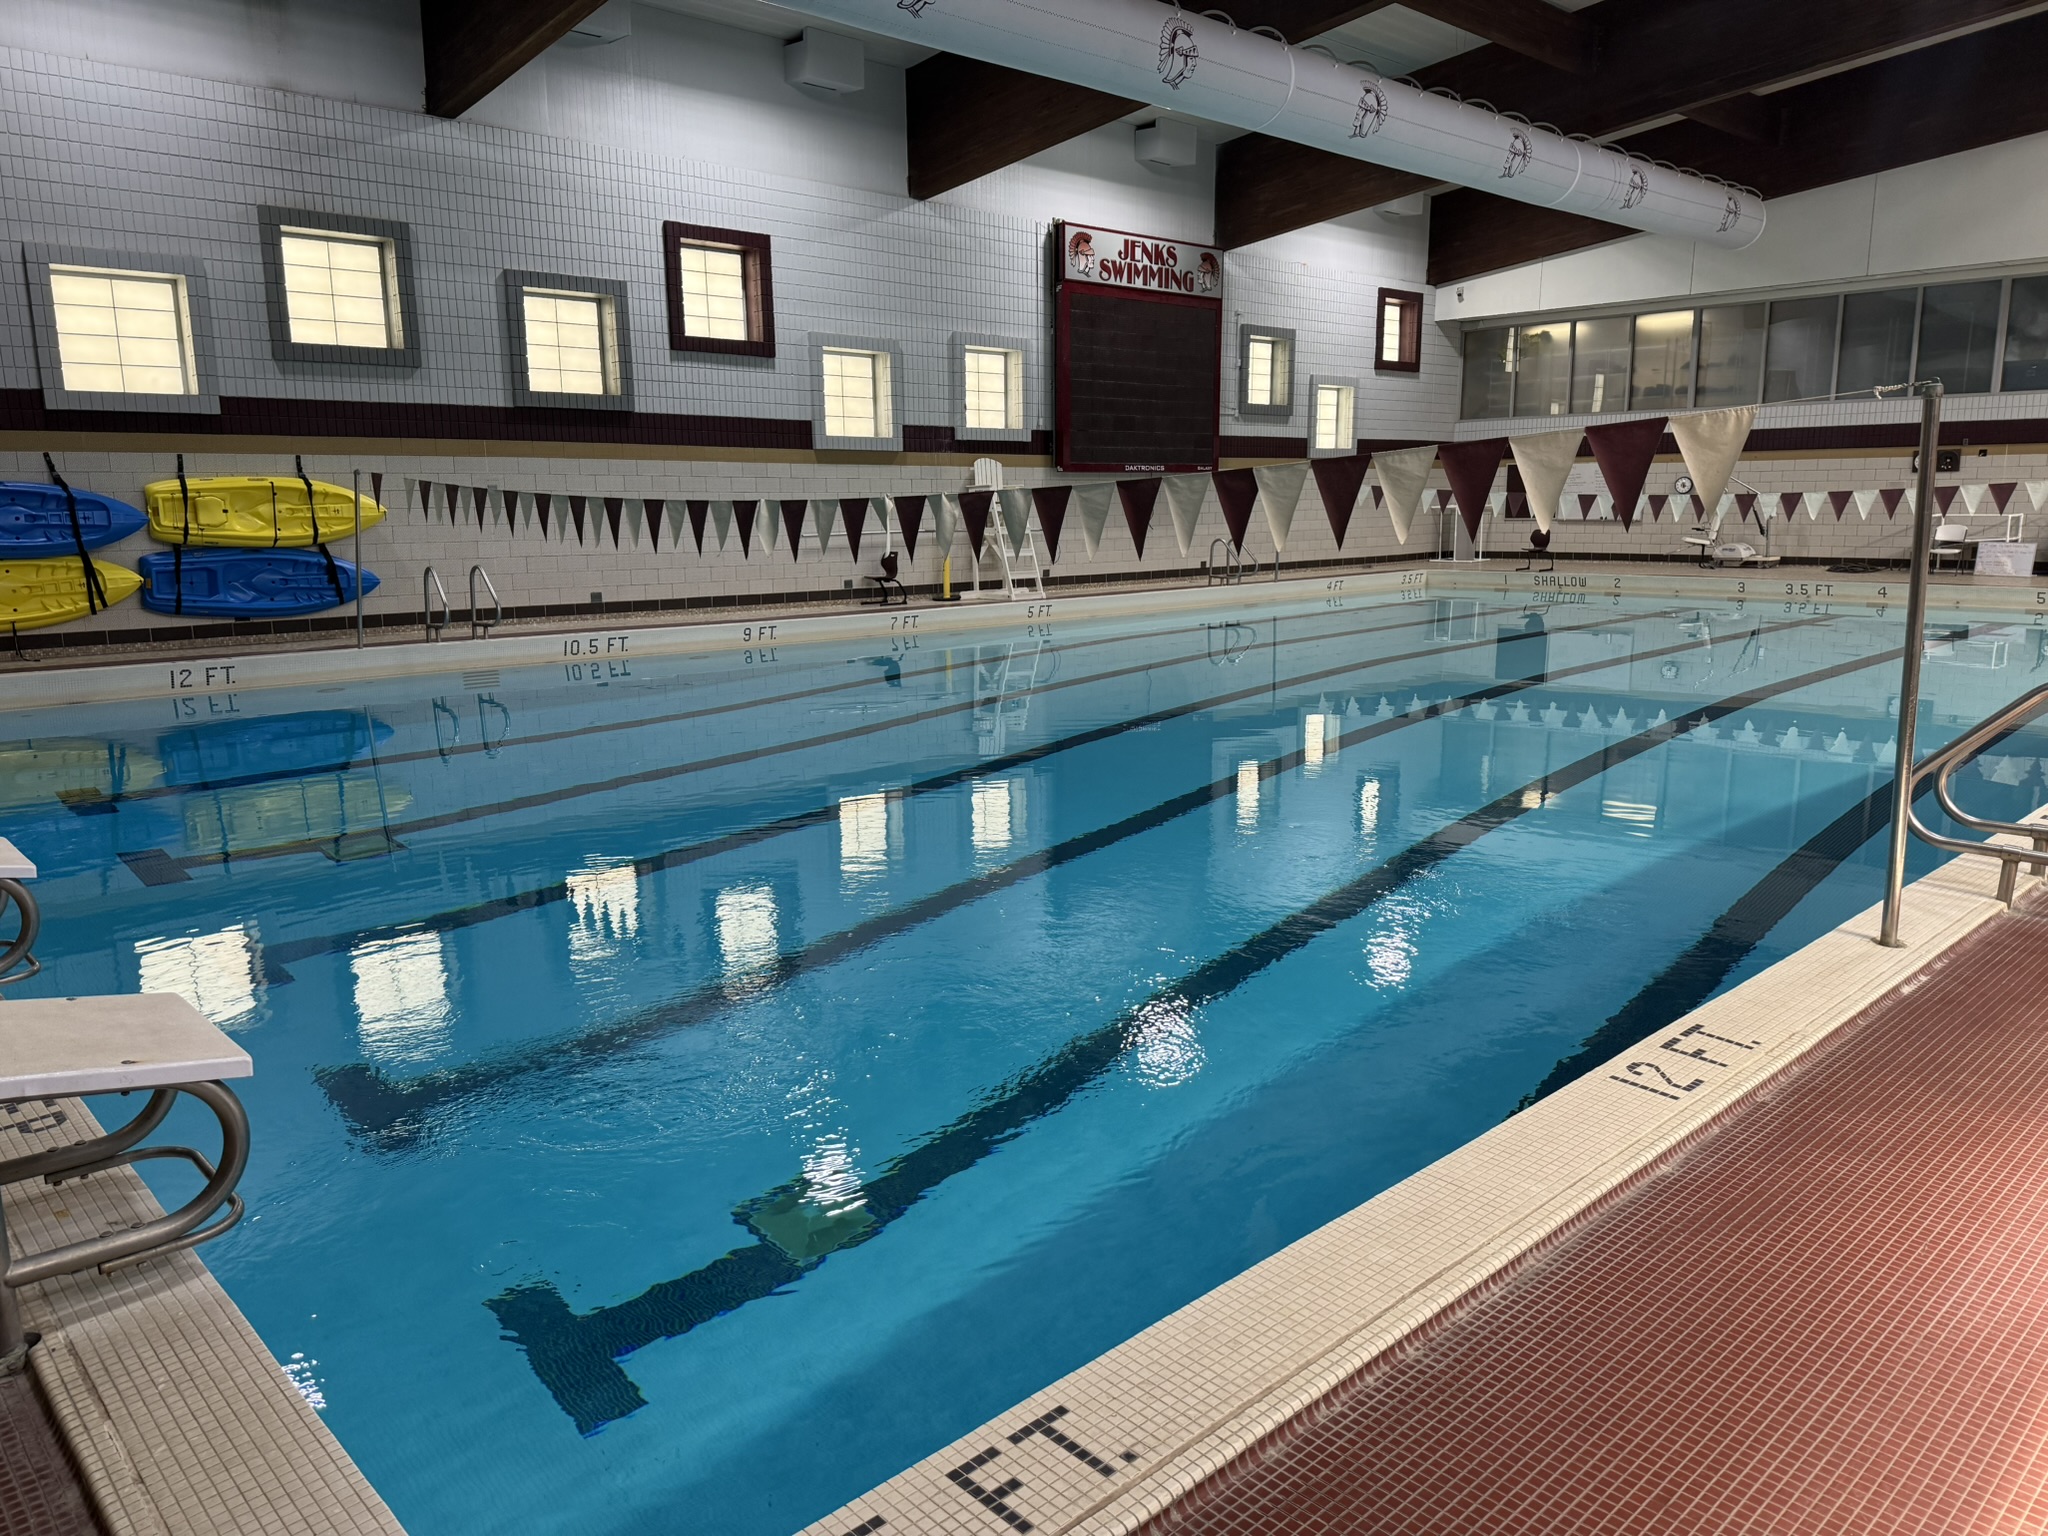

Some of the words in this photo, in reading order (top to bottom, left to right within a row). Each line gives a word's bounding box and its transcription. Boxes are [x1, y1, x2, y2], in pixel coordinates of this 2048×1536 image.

[1118, 238, 1178, 268] JENKS
[1099, 258, 1194, 293] SWIMMING
[1326, 581, 1332, 591] 4
[1401, 574, 1413, 585] 3.5
[1534, 575, 1587, 588] SHALLOW
[1614, 577, 1621, 588] 2
[1738, 581, 1745, 593] 3
[1785, 583, 1808, 596] 3.5
[1815, 584, 1834, 597] FT.
[1877, 586, 1888, 598] 4
[2036, 591, 2046, 605] 5
[1027, 605, 1035, 618] 5
[1038, 604, 1052, 618] FT.
[891, 616, 898, 630] 7
[902, 615, 919, 629] FT.
[743, 627, 751, 642] 9
[758, 625, 777, 641] FT.
[564, 638, 598, 656] 10.5
[607, 636, 629, 653] FT.
[170, 669, 193, 689] 12
[205, 665, 236, 686] FT.
[1609, 1061, 1705, 1101] 12
[1660, 1023, 1762, 1068] FT.
[945, 1404, 1140, 1535] FT.
